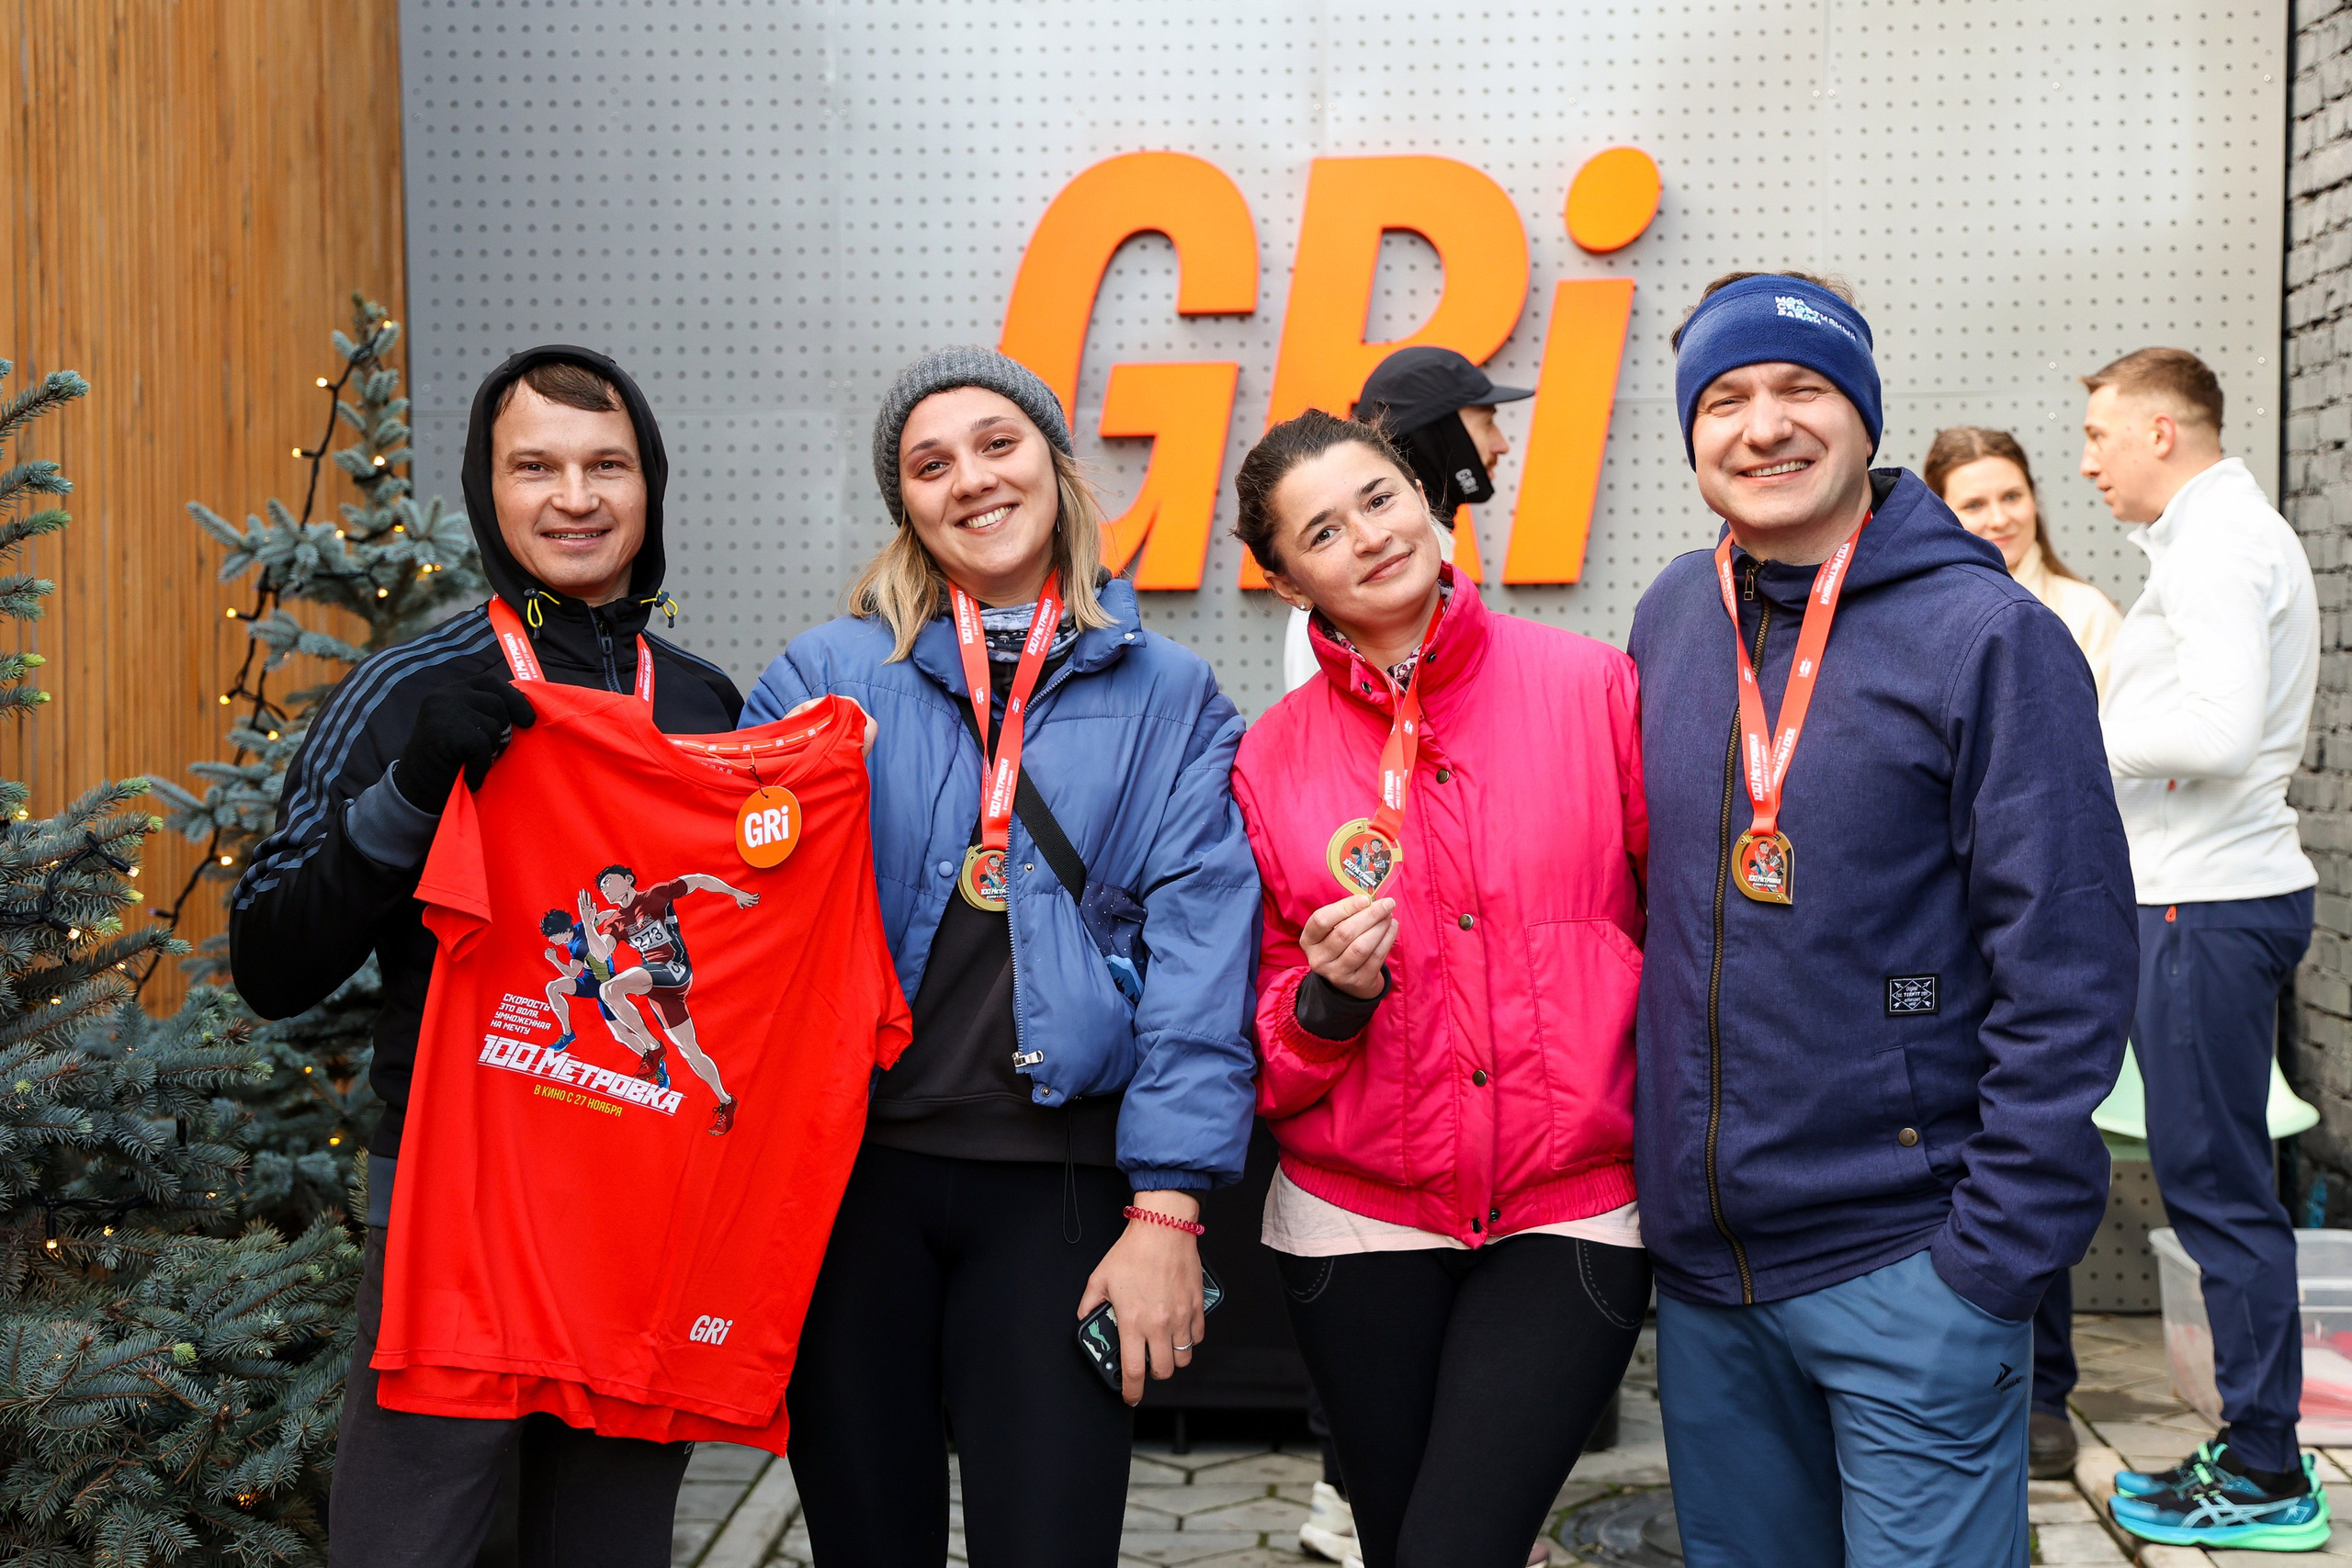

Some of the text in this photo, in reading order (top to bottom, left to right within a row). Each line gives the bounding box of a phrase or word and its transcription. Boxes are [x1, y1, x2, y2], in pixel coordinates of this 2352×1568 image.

[999, 146, 1663, 590] GRi
[960, 626, 974, 645] 100
[1027, 598, 1053, 657] 100 МЕТРОВКА
[1782, 728, 1796, 748] 100
[1748, 733, 1764, 801] 100 МЕТРОВКА
[989, 757, 1010, 818] 100 МЕТРОВКА
[744, 805, 789, 848] GRi
[635, 927, 663, 948] 273
[498, 1002, 539, 1019] ЭТО ВОЛЯ,
[503, 993, 551, 1011] СКОРОСТЬ
[490, 1020, 531, 1034] НА МЕЧТУ
[494, 1010, 551, 1031] УМНОЖЕННАЯ
[478, 1033, 684, 1113] 100 МЕТРОВКА
[534, 1084, 623, 1117] В КИНО С 27 НОЯБРЯ
[689, 1314, 733, 1346] GRi
